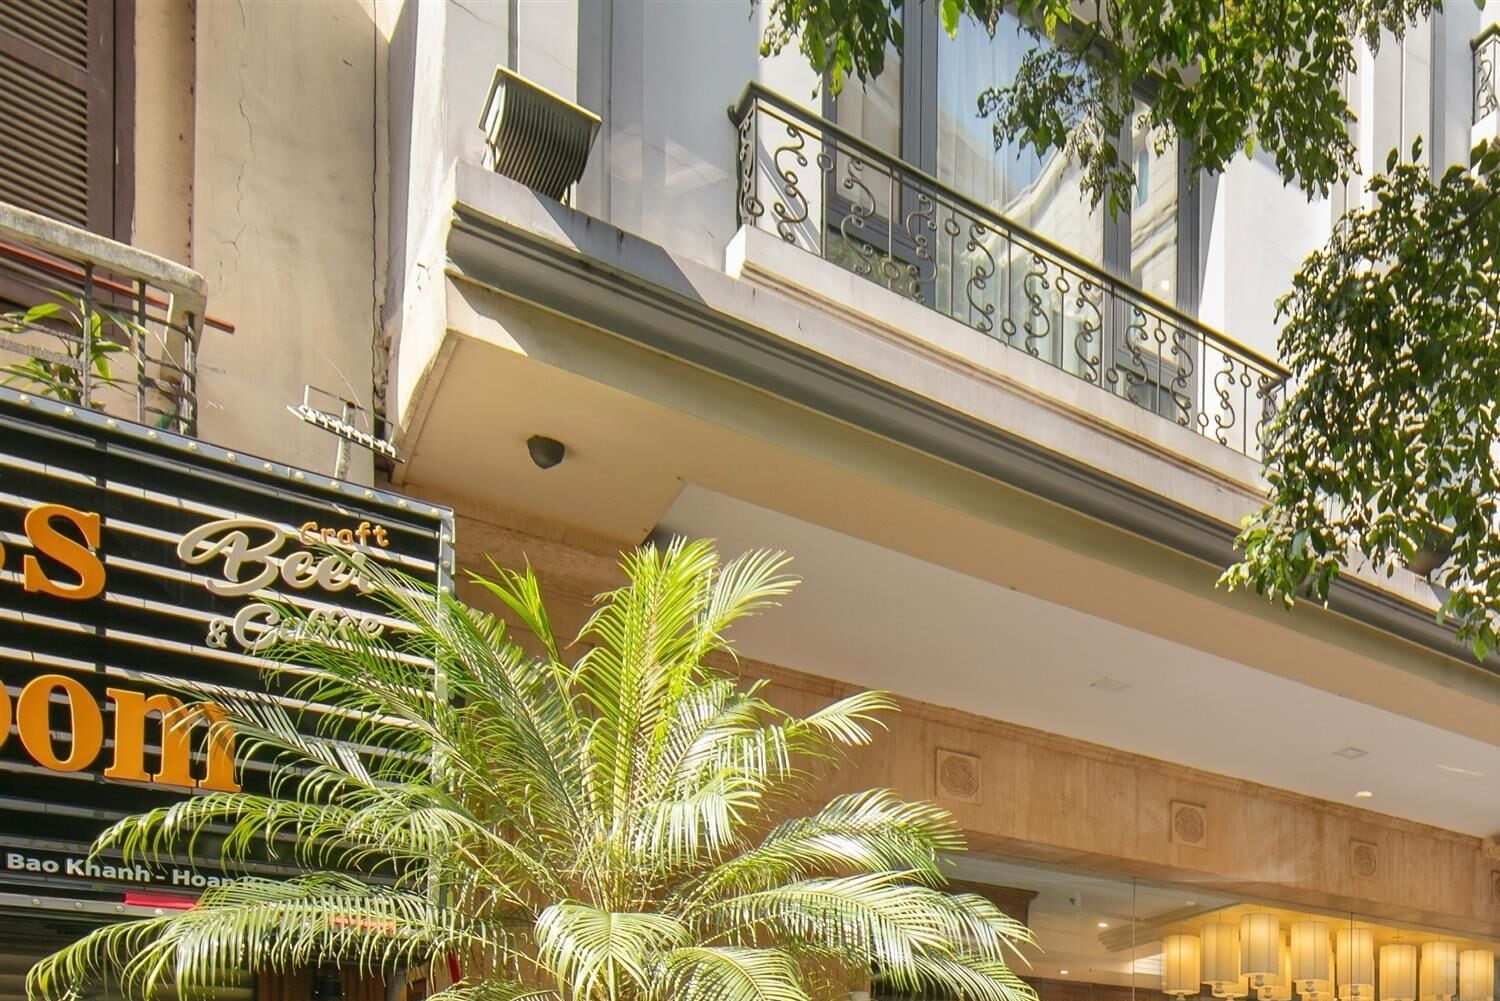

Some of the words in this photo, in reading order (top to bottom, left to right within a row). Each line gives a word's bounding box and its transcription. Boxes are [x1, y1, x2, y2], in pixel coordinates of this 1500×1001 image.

[300, 521, 389, 547] Craft
[205, 617, 227, 648] &
[0, 674, 241, 793] oom
[7, 852, 59, 873] Bao
[66, 857, 151, 882] Khanh
